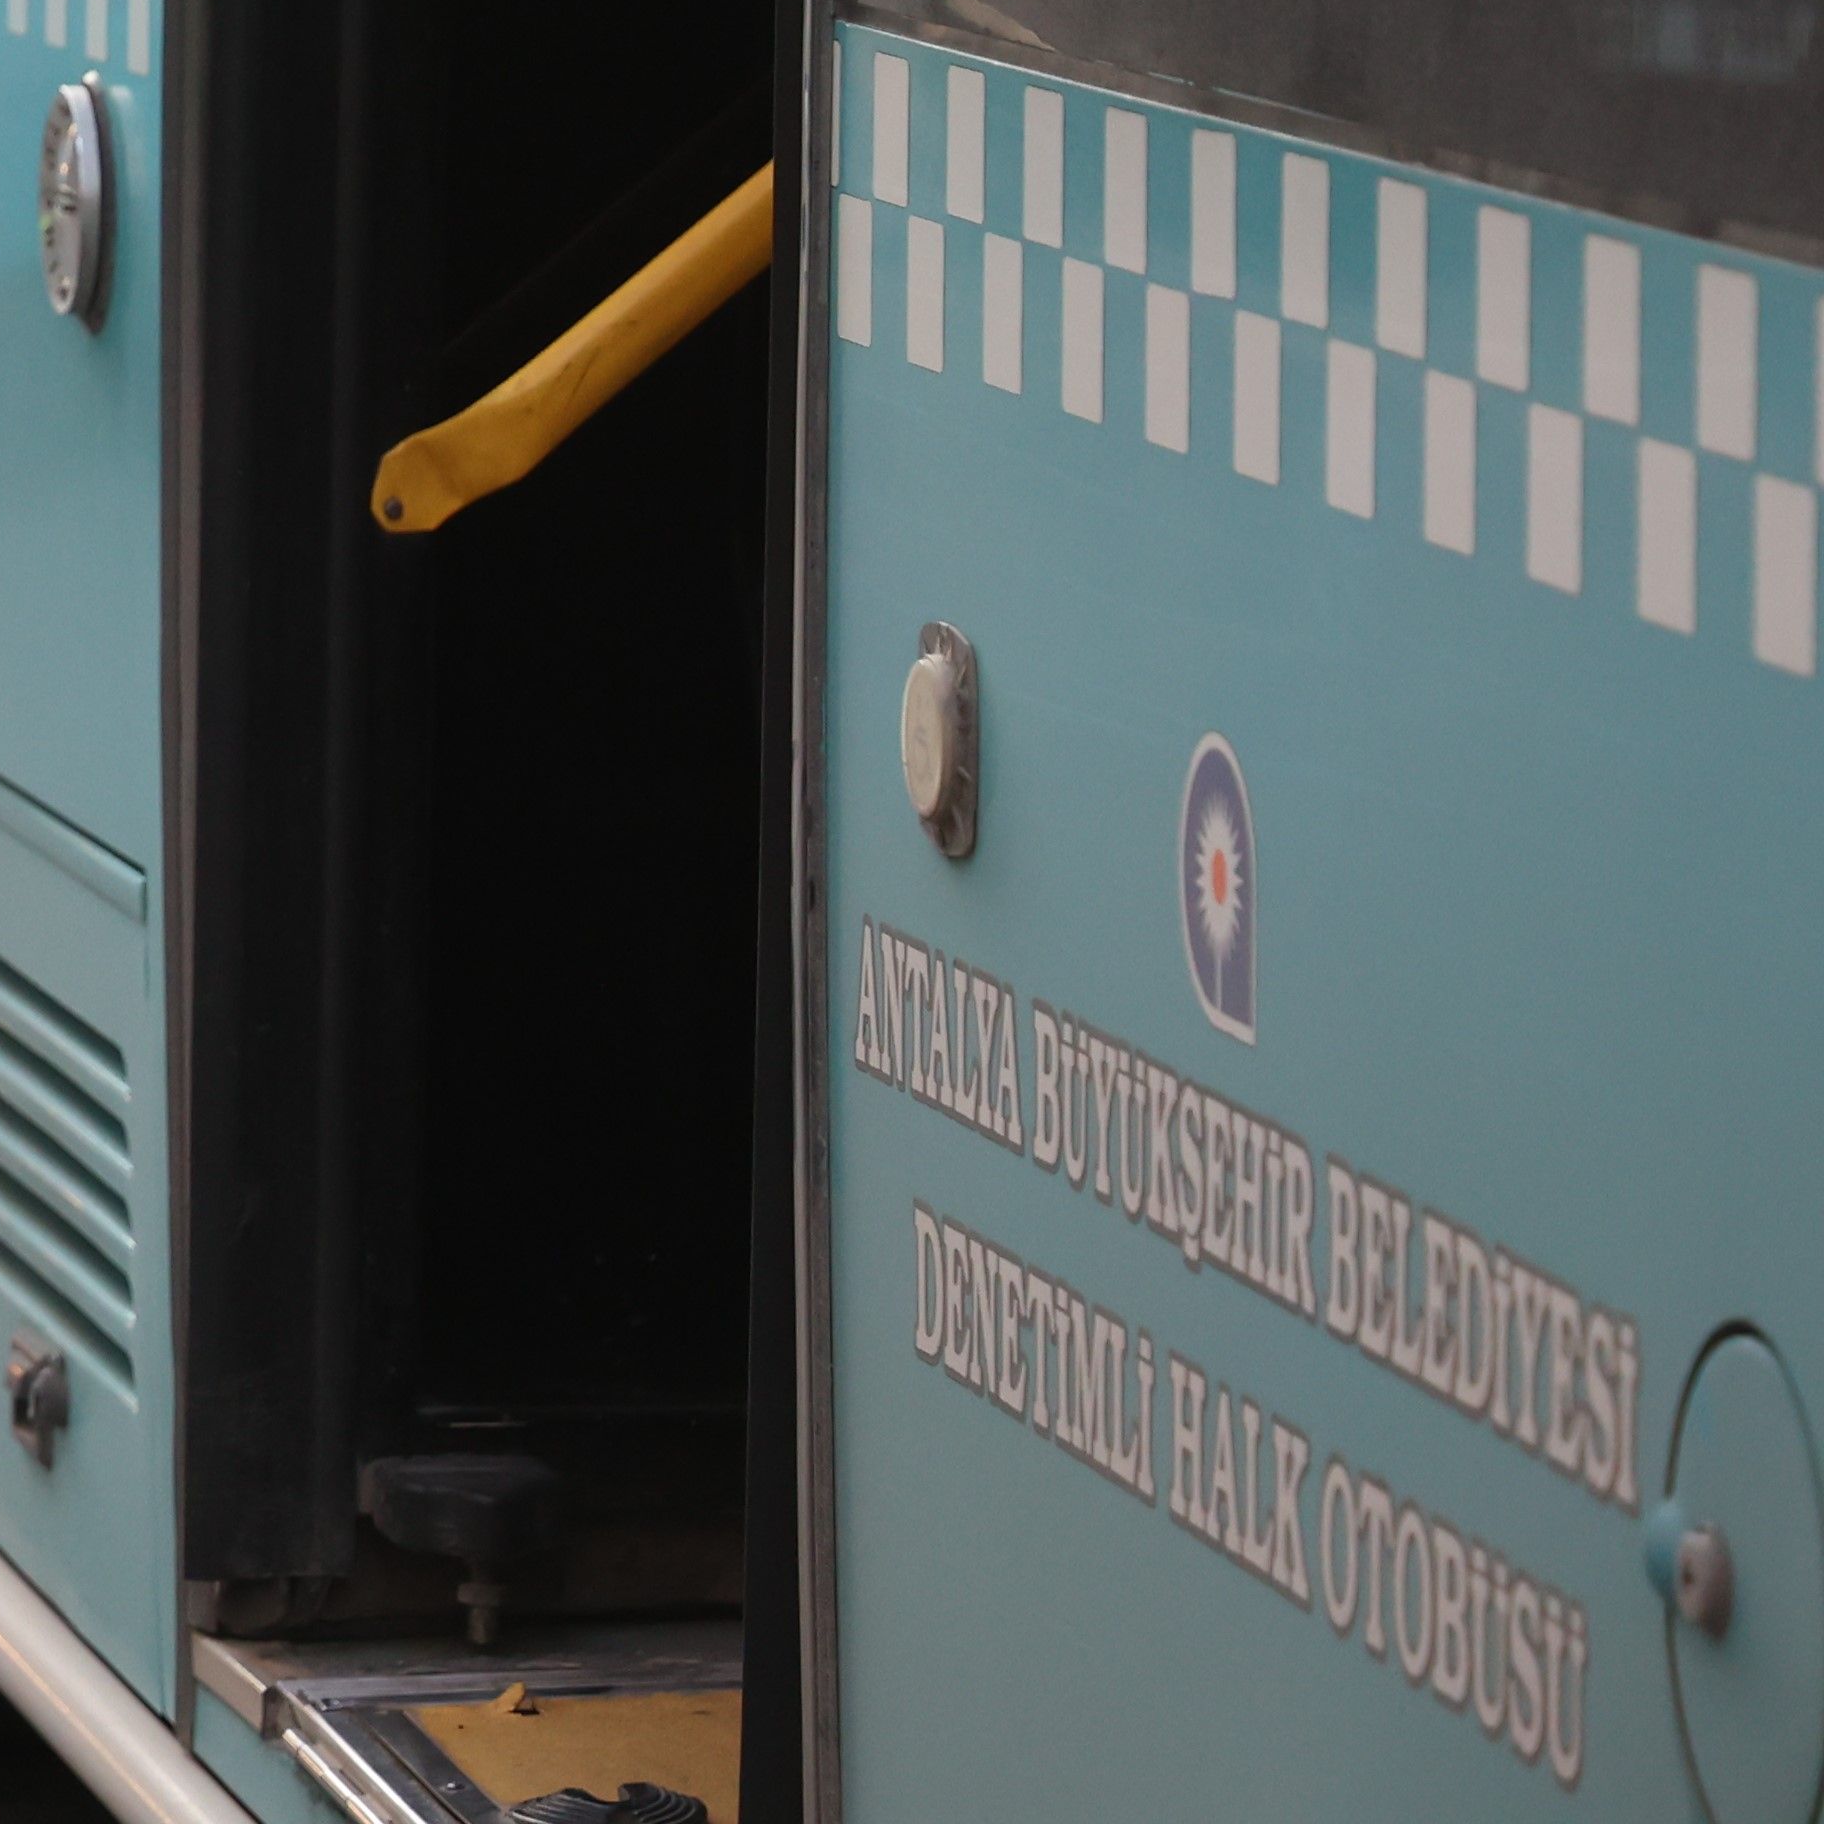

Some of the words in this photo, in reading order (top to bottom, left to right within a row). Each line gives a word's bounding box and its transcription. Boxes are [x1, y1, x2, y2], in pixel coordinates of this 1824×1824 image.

[855, 916, 1024, 1156] ANTALYA
[1032, 1000, 1316, 1326] BÜYÜKŞEHİR
[1326, 1151, 1642, 1516] BELEDİYESİ
[913, 1198, 1154, 1504] DENETİMLİ
[1169, 1348, 1311, 1611] HALK
[1321, 1452, 1588, 1792] OTOBÜSÜ
